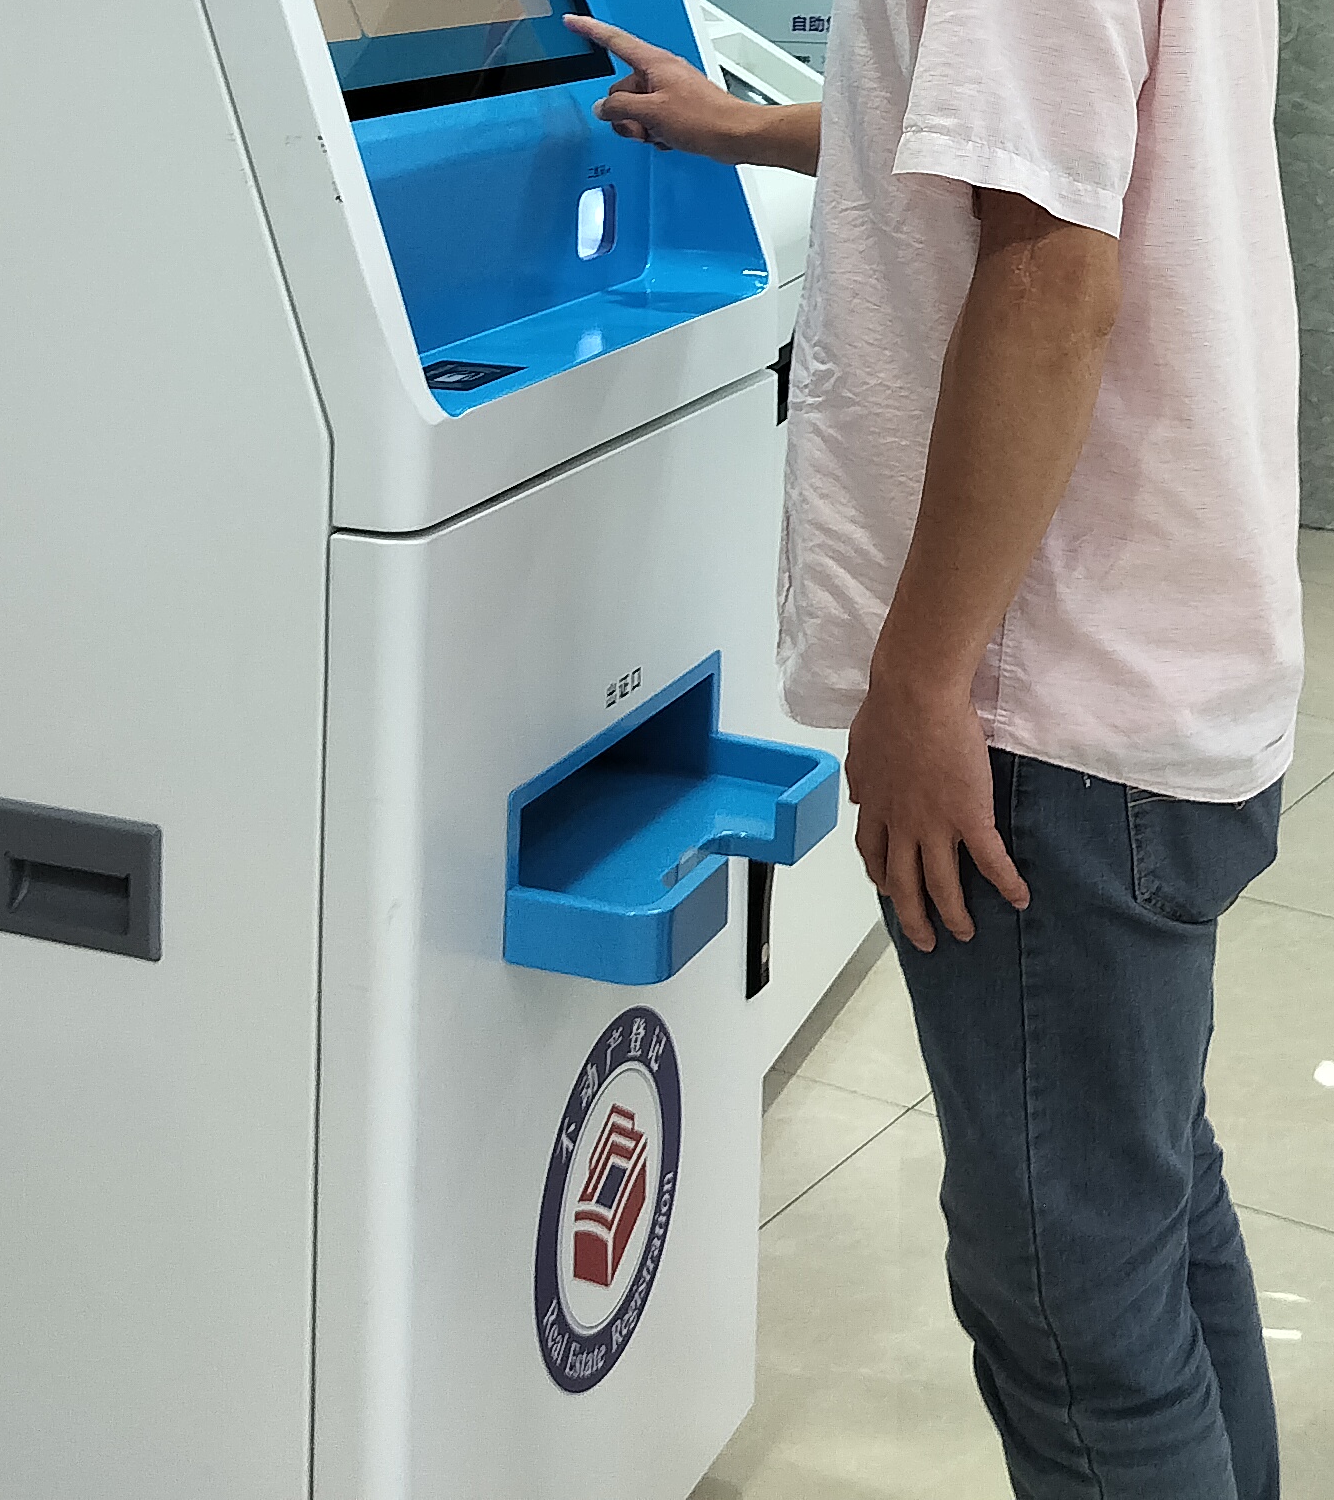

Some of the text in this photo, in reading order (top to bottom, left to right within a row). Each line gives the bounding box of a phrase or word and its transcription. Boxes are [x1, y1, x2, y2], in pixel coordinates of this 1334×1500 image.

[791, 15, 832, 33] 自助
[556, 1017, 667, 1164] 不动产登记
[542, 1298, 570, 1367] Real
[565, 1340, 607, 1380] Estate
